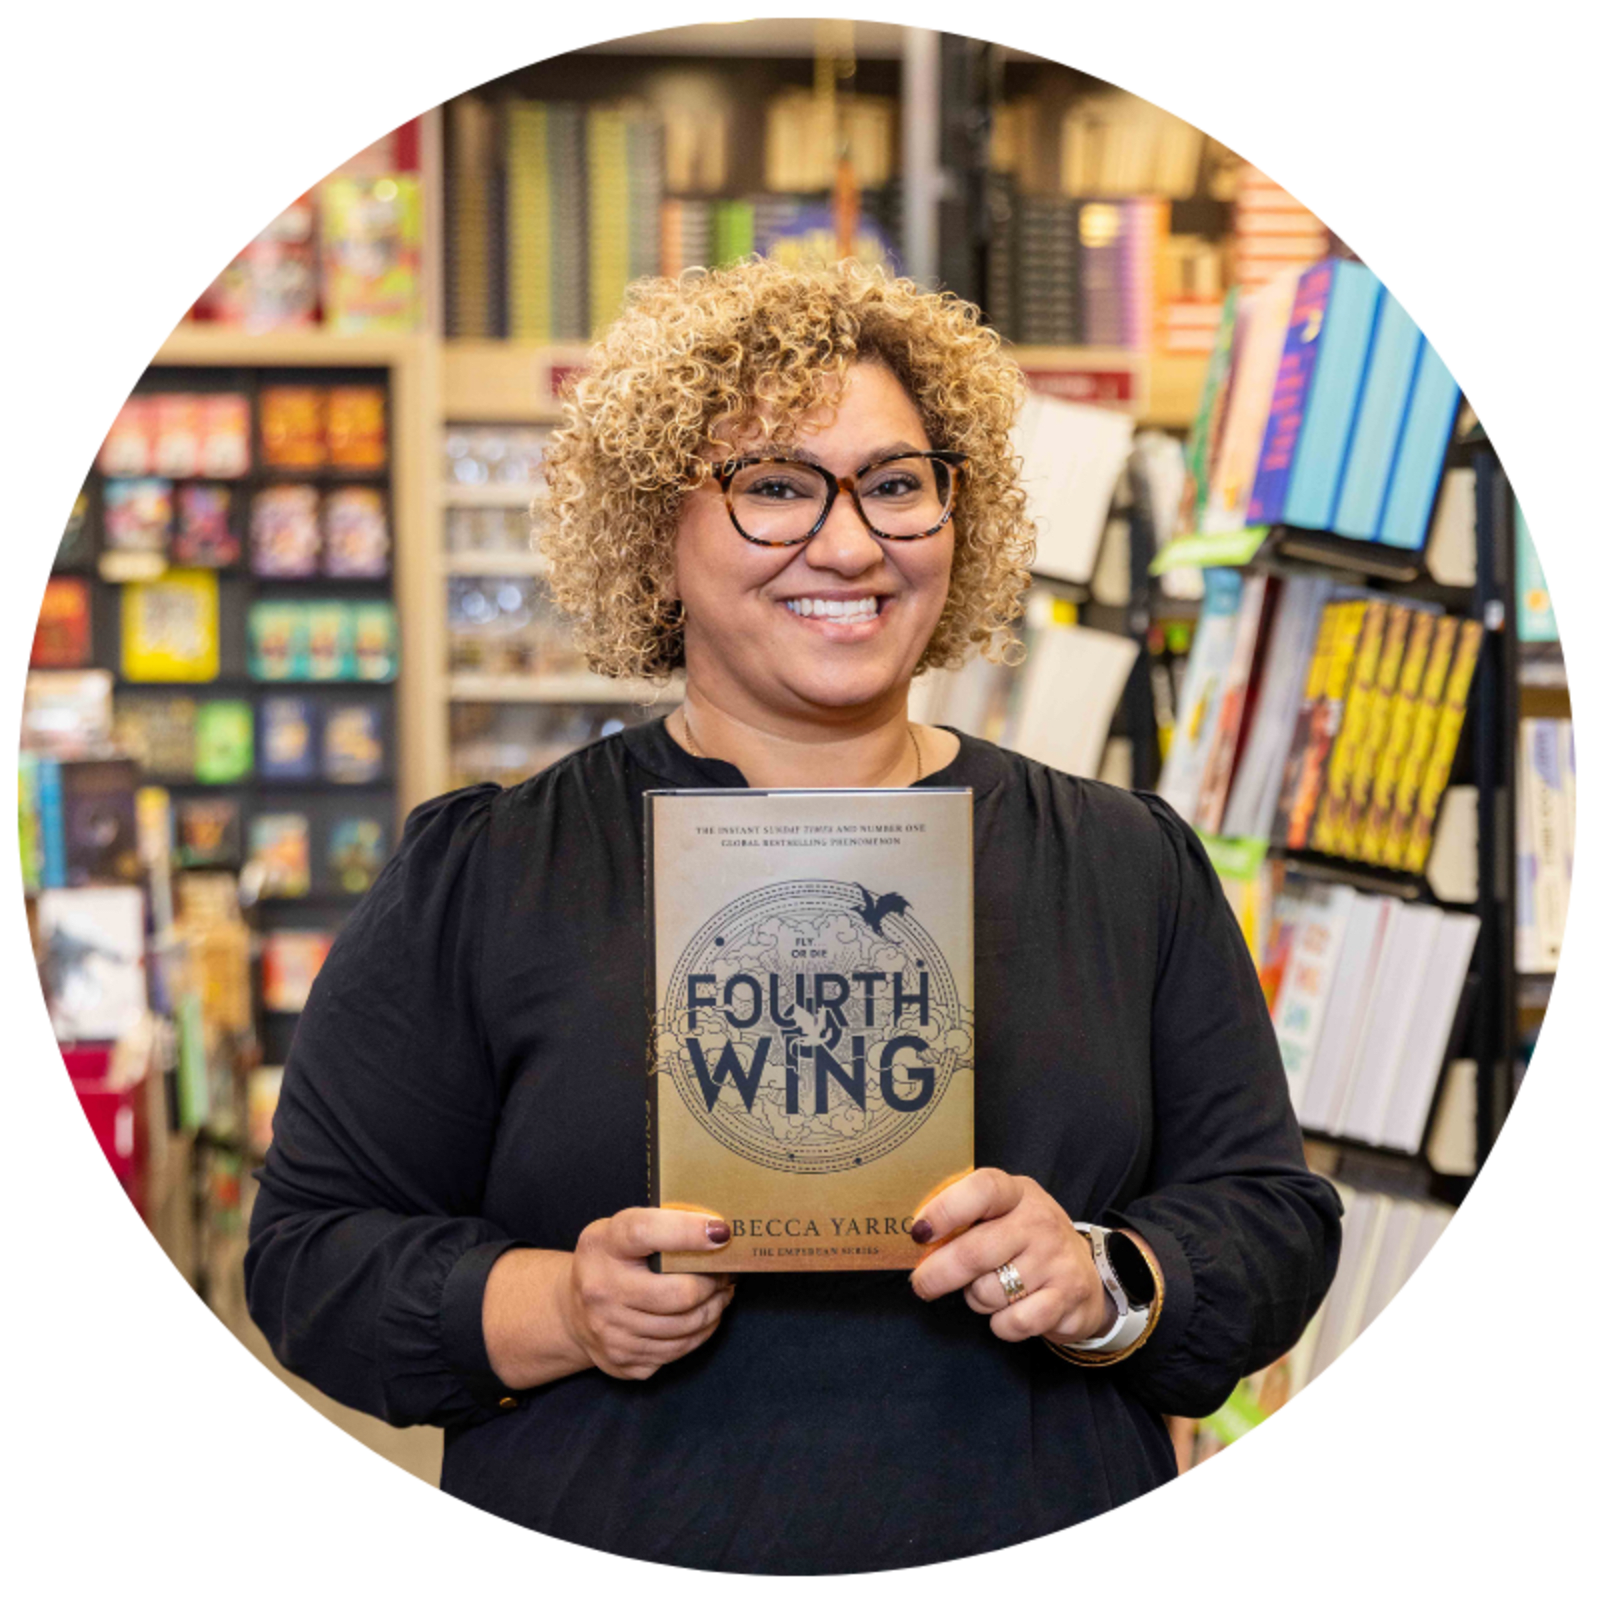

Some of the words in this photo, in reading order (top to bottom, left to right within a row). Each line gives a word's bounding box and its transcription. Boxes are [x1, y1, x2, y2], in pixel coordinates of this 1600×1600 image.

[696, 825, 715, 835] THE
[718, 825, 760, 835] INSTANT
[836, 824, 858, 833] AND
[860, 824, 903, 833] NUMBER
[905, 823, 927, 833] ONE
[721, 839, 760, 847] GLOBAL
[830, 837, 901, 847] PHENOMENON
[791, 949, 807, 958] OR
[810, 949, 827, 958] DIE
[688, 971, 929, 1029] FOURTH
[685, 1035, 936, 1114] WING
[732, 1218, 821, 1237] BECCA
[830, 1216, 914, 1236] YARRO
[753, 1247, 775, 1257] THE
[841, 1246, 879, 1255] SERIES
